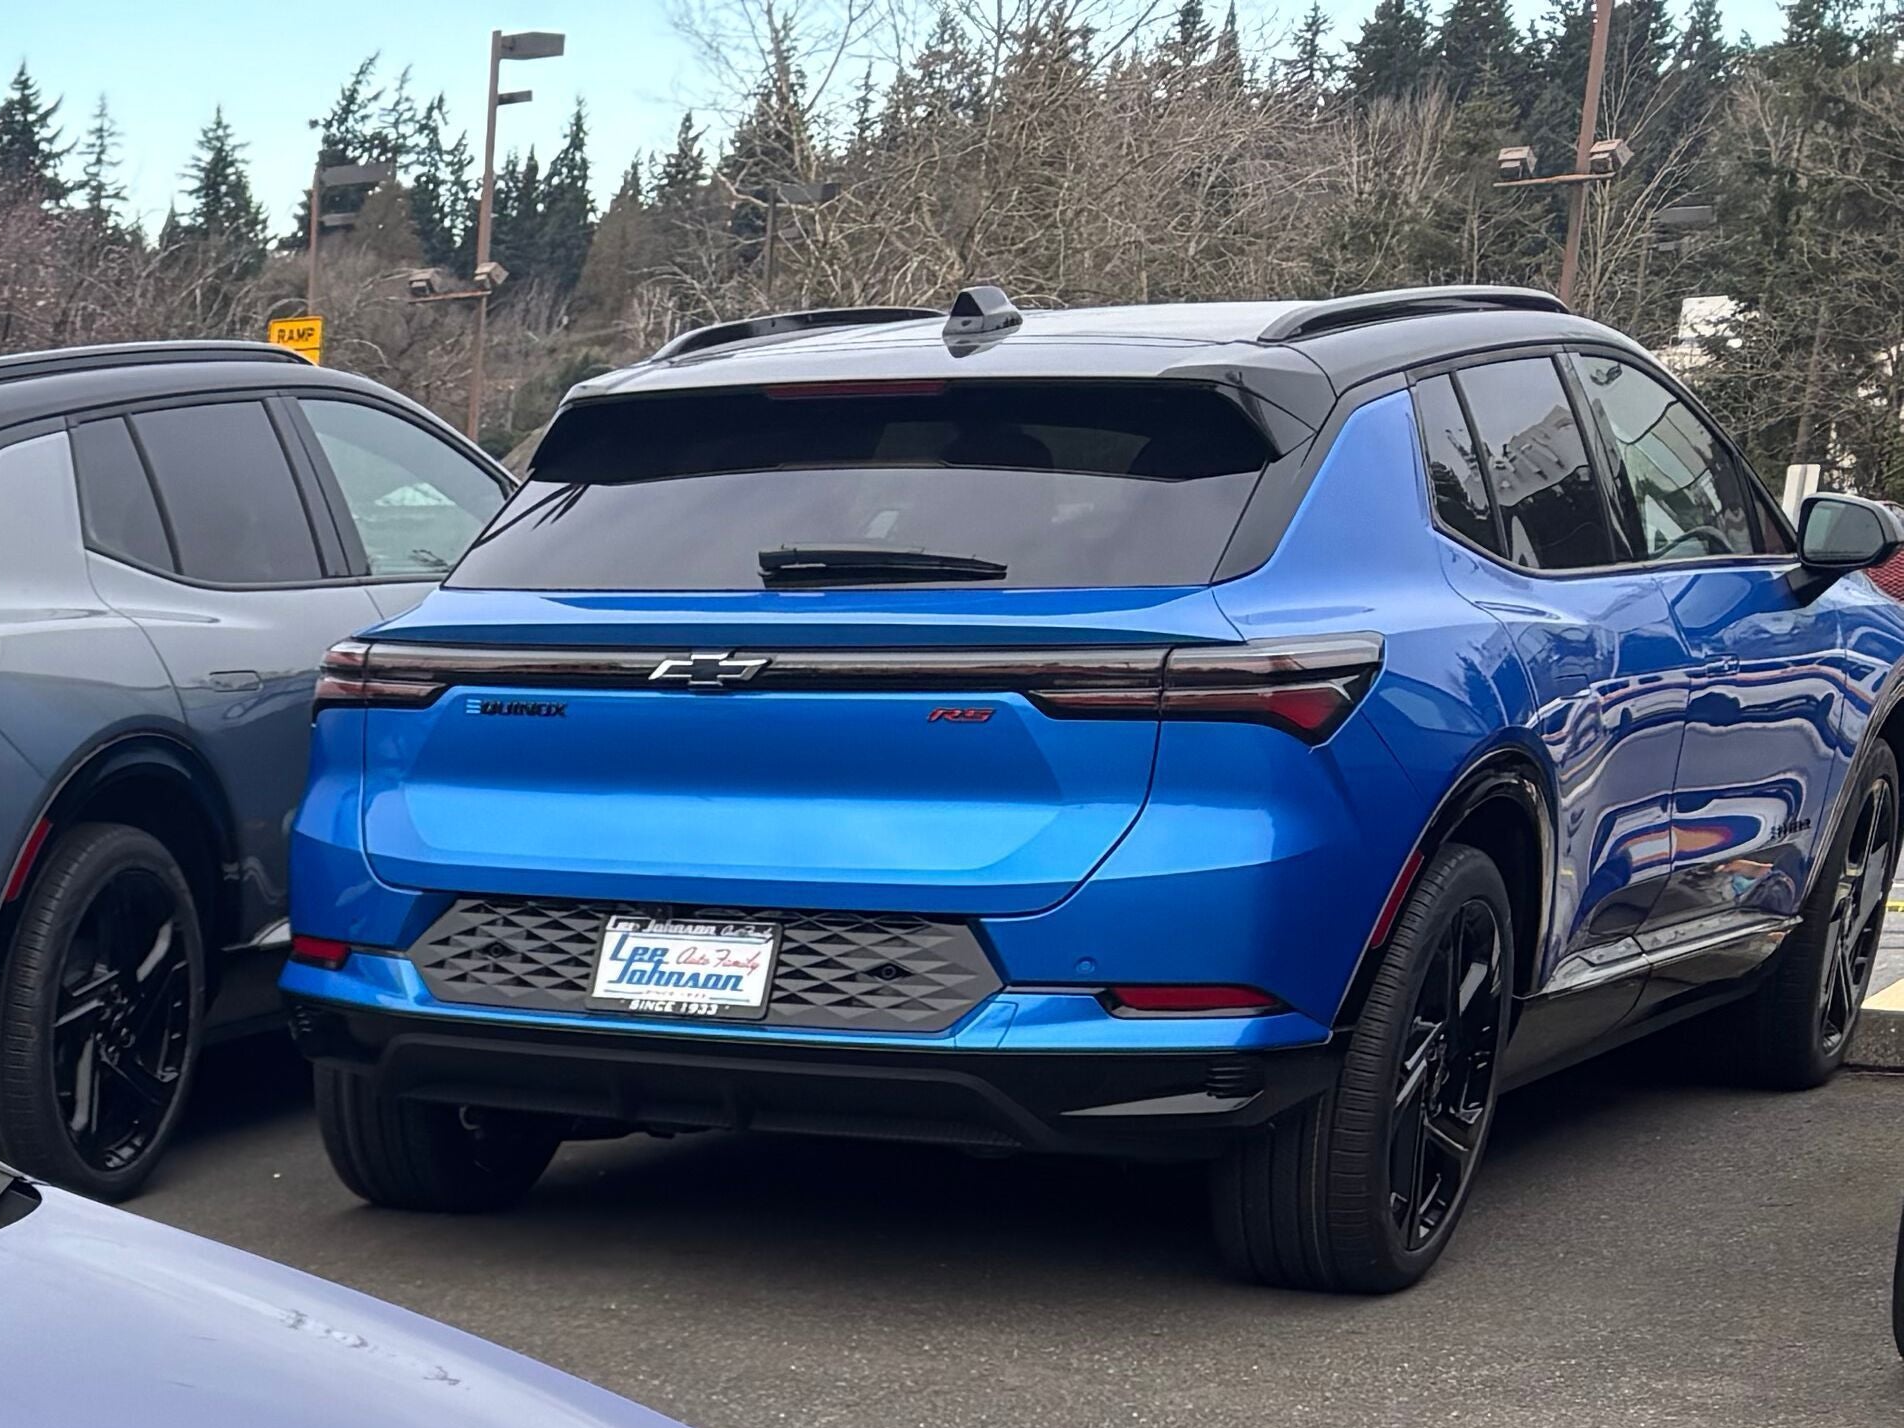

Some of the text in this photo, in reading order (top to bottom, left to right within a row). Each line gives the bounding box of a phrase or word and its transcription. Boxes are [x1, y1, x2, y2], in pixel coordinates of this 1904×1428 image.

[277, 326, 316, 344] RAMP
[466, 699, 567, 718] EQUINOX
[927, 708, 996, 723] RS
[642, 919, 717, 936] Johnson
[609, 933, 670, 964] Lee
[676, 946, 762, 976] Auto Family
[607, 957, 745, 992] Johnson
[628, 1000, 719, 1015] SINCE 1933
